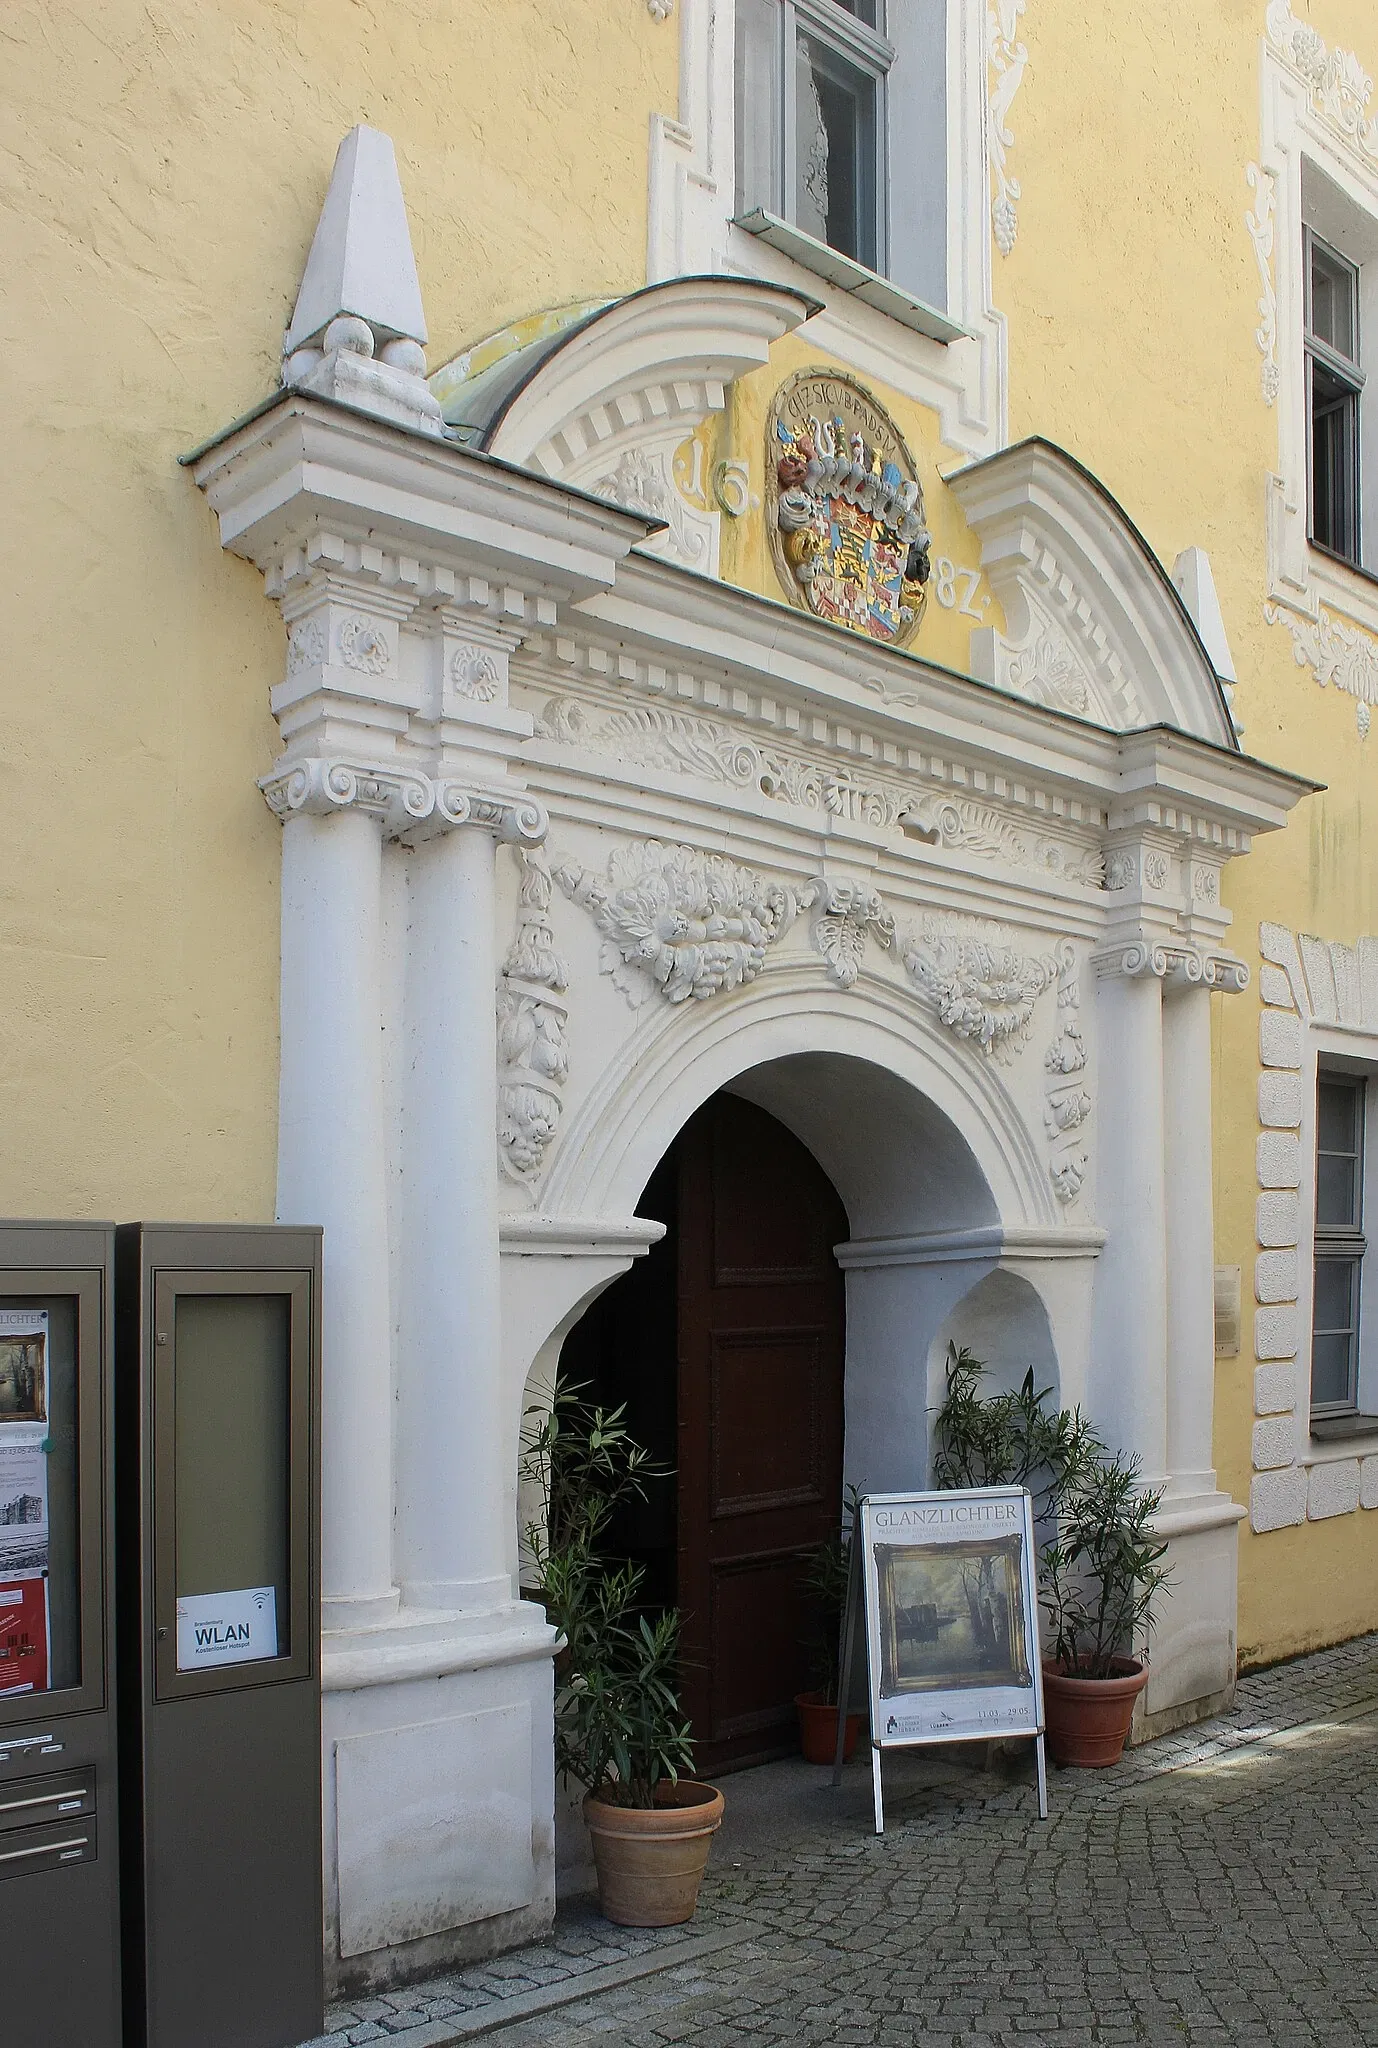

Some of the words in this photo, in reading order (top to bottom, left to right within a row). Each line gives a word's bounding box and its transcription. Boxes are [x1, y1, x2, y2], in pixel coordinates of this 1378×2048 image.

[875, 1504, 1018, 1527] GLANZLICHTER
[195, 1623, 250, 1646] WLAN
[195, 1645, 228, 1654] Kostenloser
[228, 1641, 250, 1651] Hotspot
